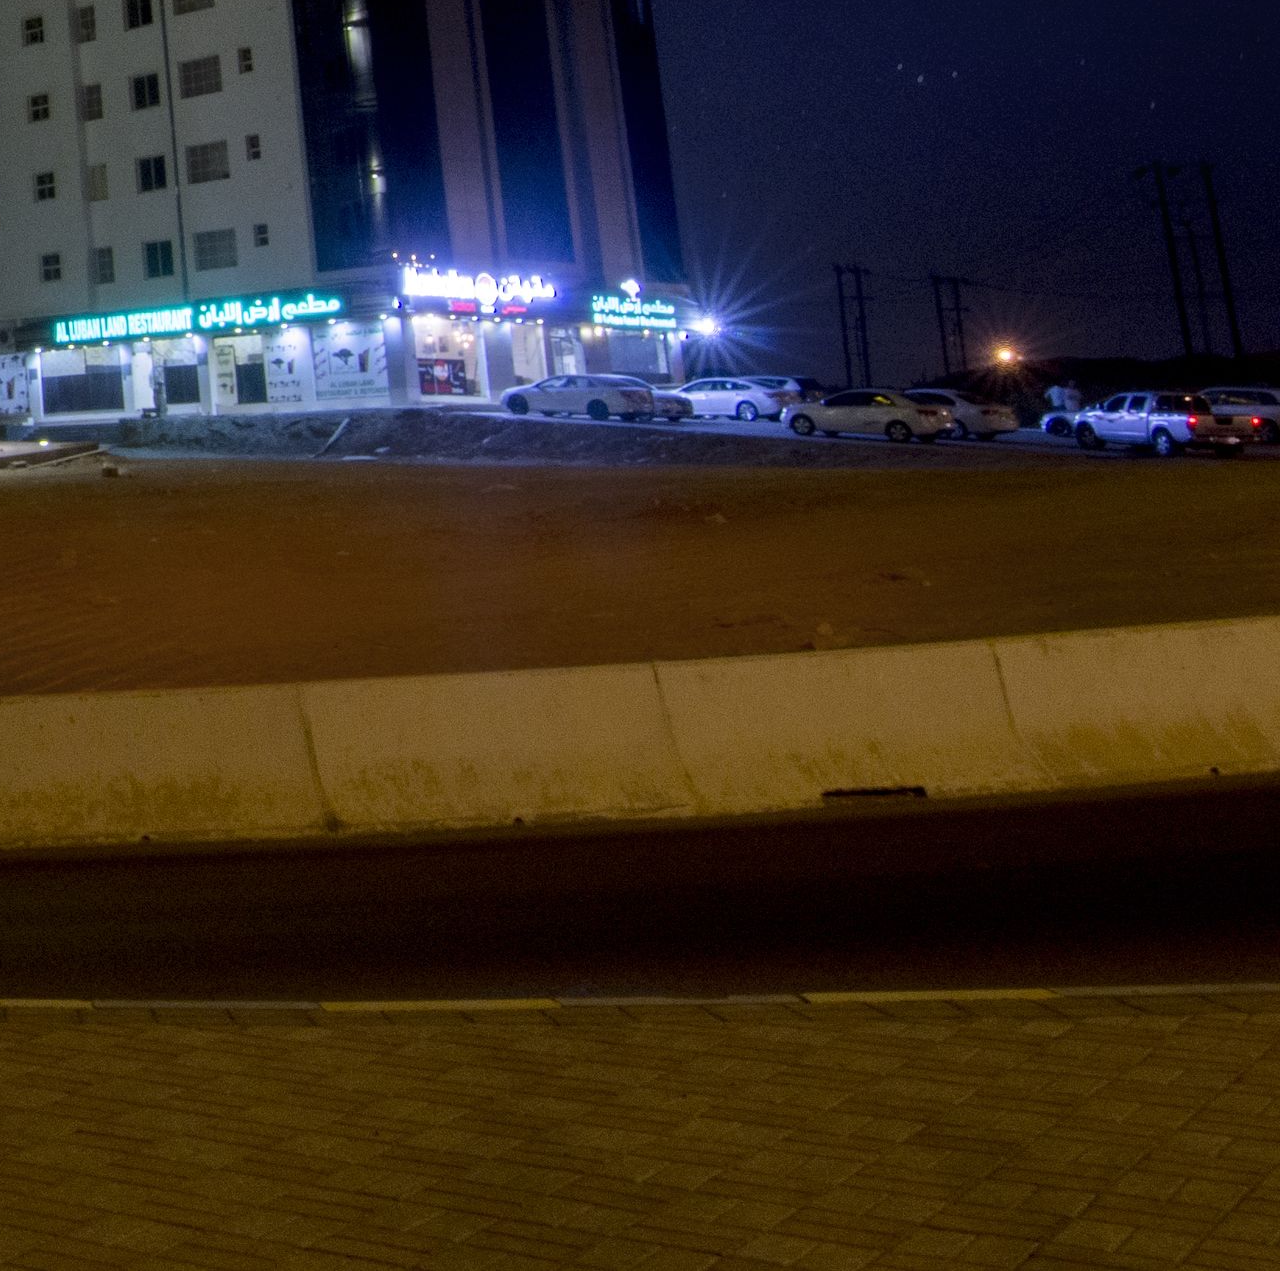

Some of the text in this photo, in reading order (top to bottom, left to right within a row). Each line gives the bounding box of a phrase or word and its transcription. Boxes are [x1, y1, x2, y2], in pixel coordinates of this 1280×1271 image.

[198, 301, 243, 329] اللبان
[282, 294, 341, 321] مطعم
[55, 307, 193, 343] AL LUBAN LAND RESTAURANT
